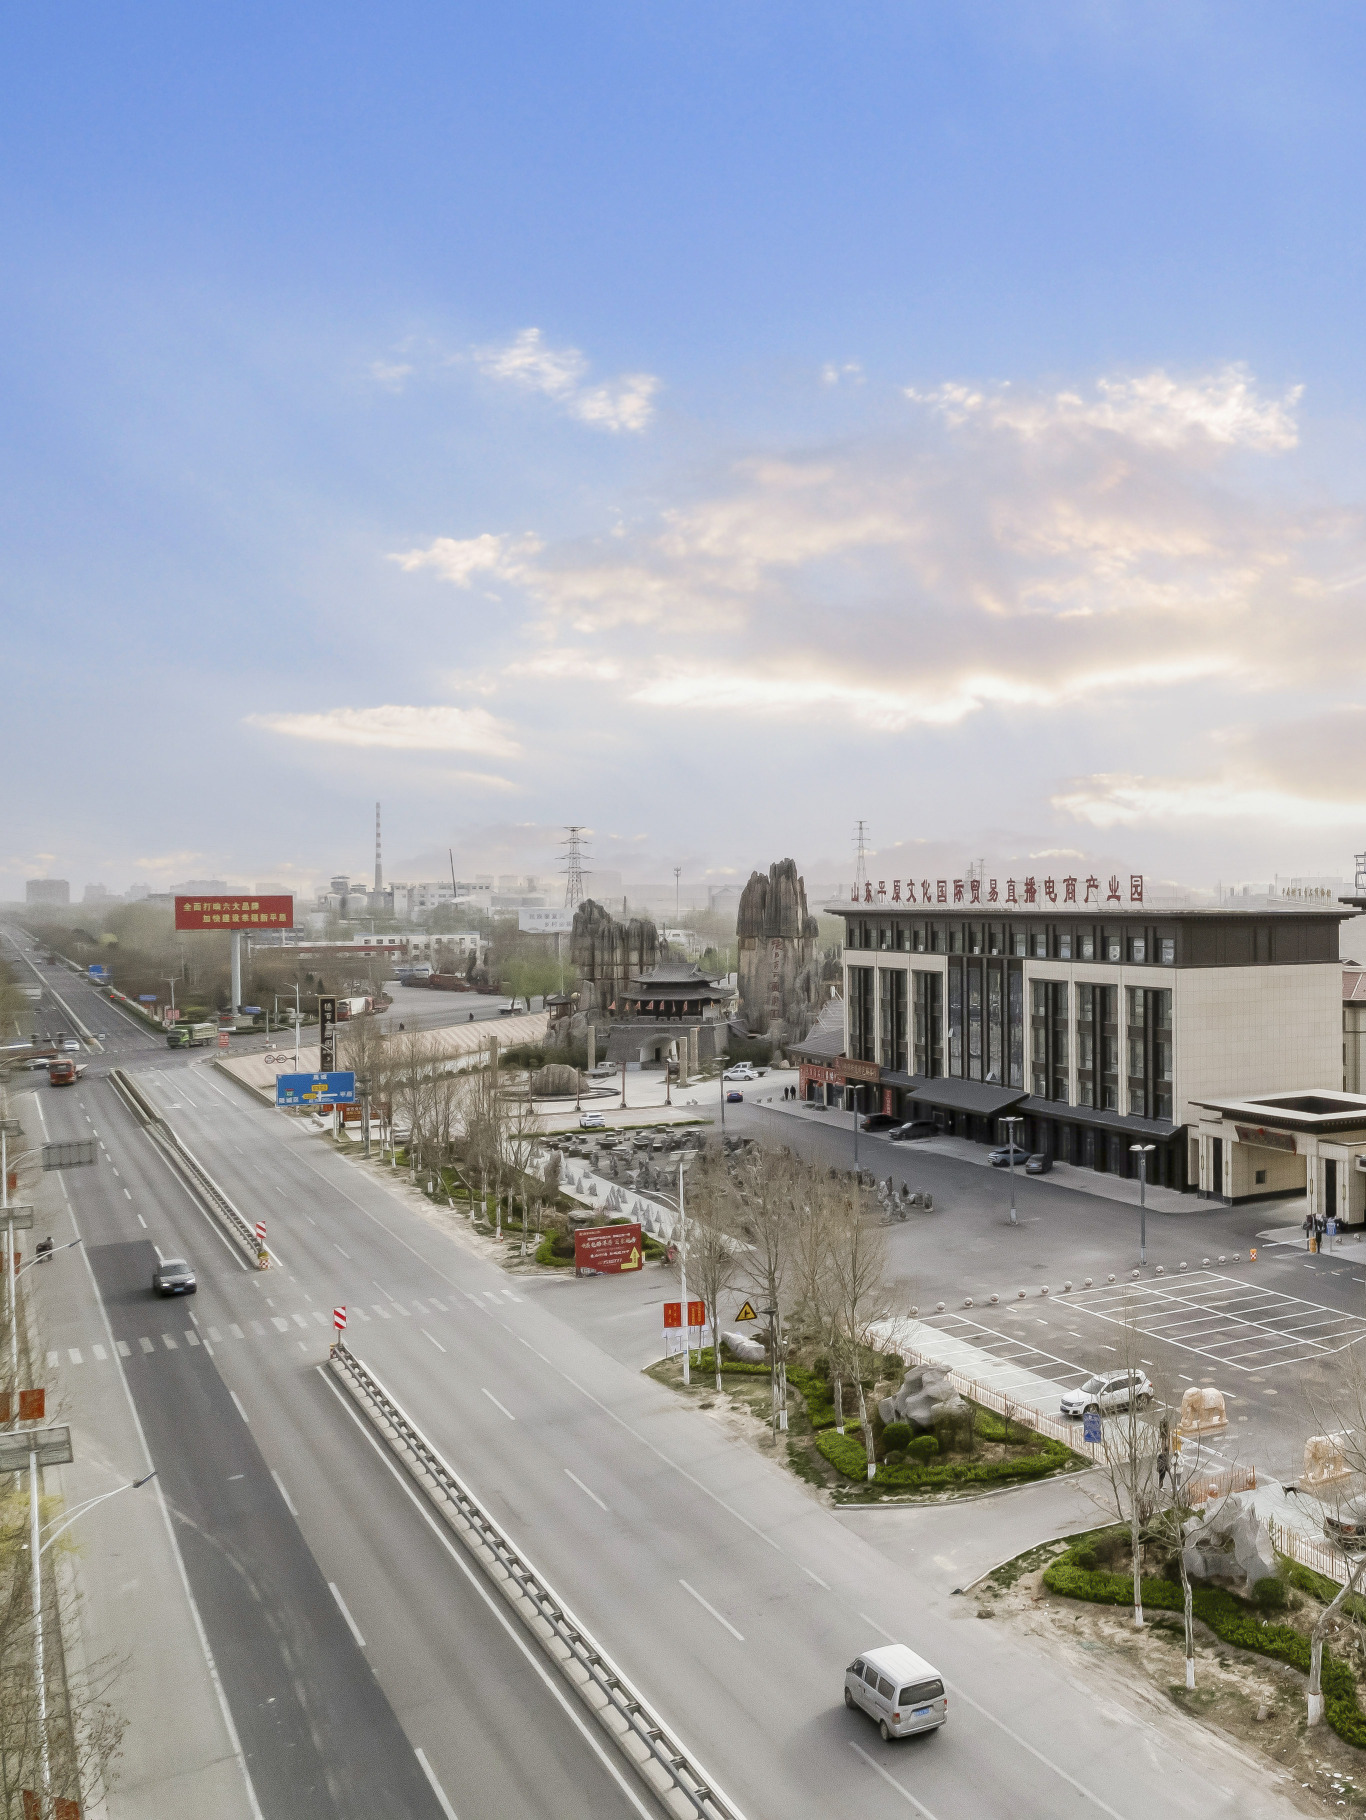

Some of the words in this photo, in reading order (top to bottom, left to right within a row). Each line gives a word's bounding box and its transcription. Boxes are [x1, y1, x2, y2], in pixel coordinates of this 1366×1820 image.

[851, 875, 1144, 904] 山东平原文化国际贸易直播电商产业园
